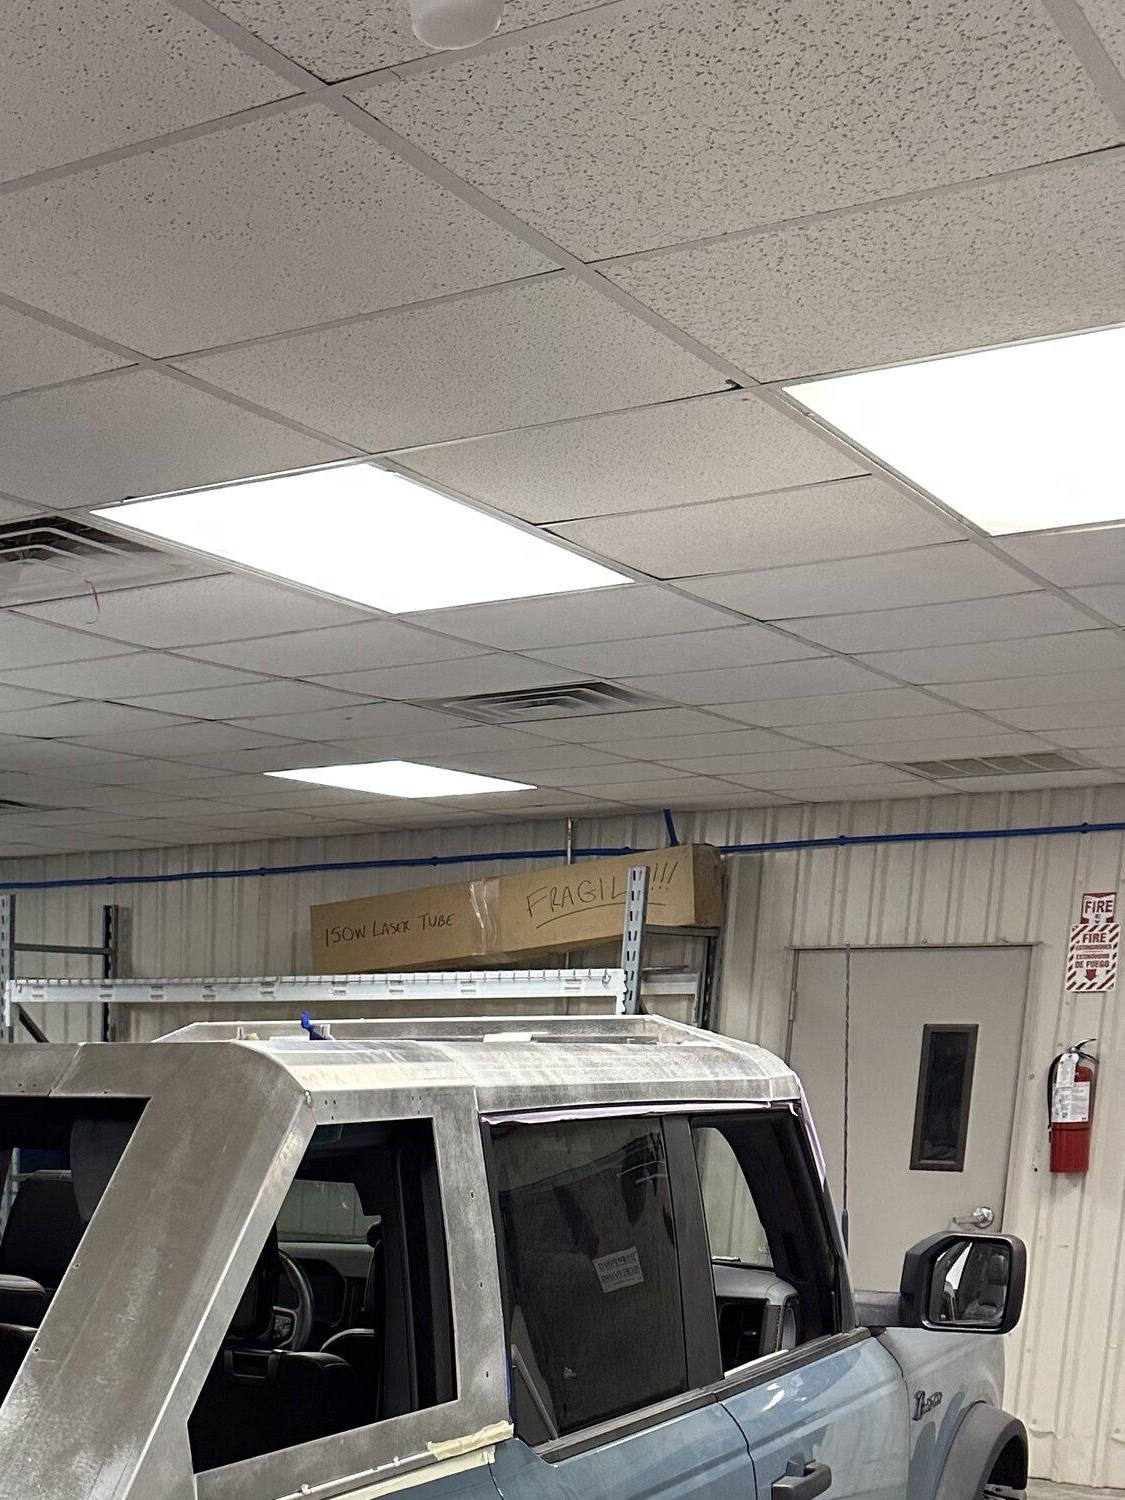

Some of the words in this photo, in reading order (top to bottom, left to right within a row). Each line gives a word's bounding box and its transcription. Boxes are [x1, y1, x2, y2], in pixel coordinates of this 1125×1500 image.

[525, 875, 628, 918] FRAGIL
[1084, 899, 1113, 914] FIRE
[325, 922, 367, 948] 150W
[420, 912, 456, 932] TUBE
[1082, 932, 1107, 943] FIRE
[1074, 960, 1084, 968] DE
[1086, 960, 1110, 968] FUEGO
